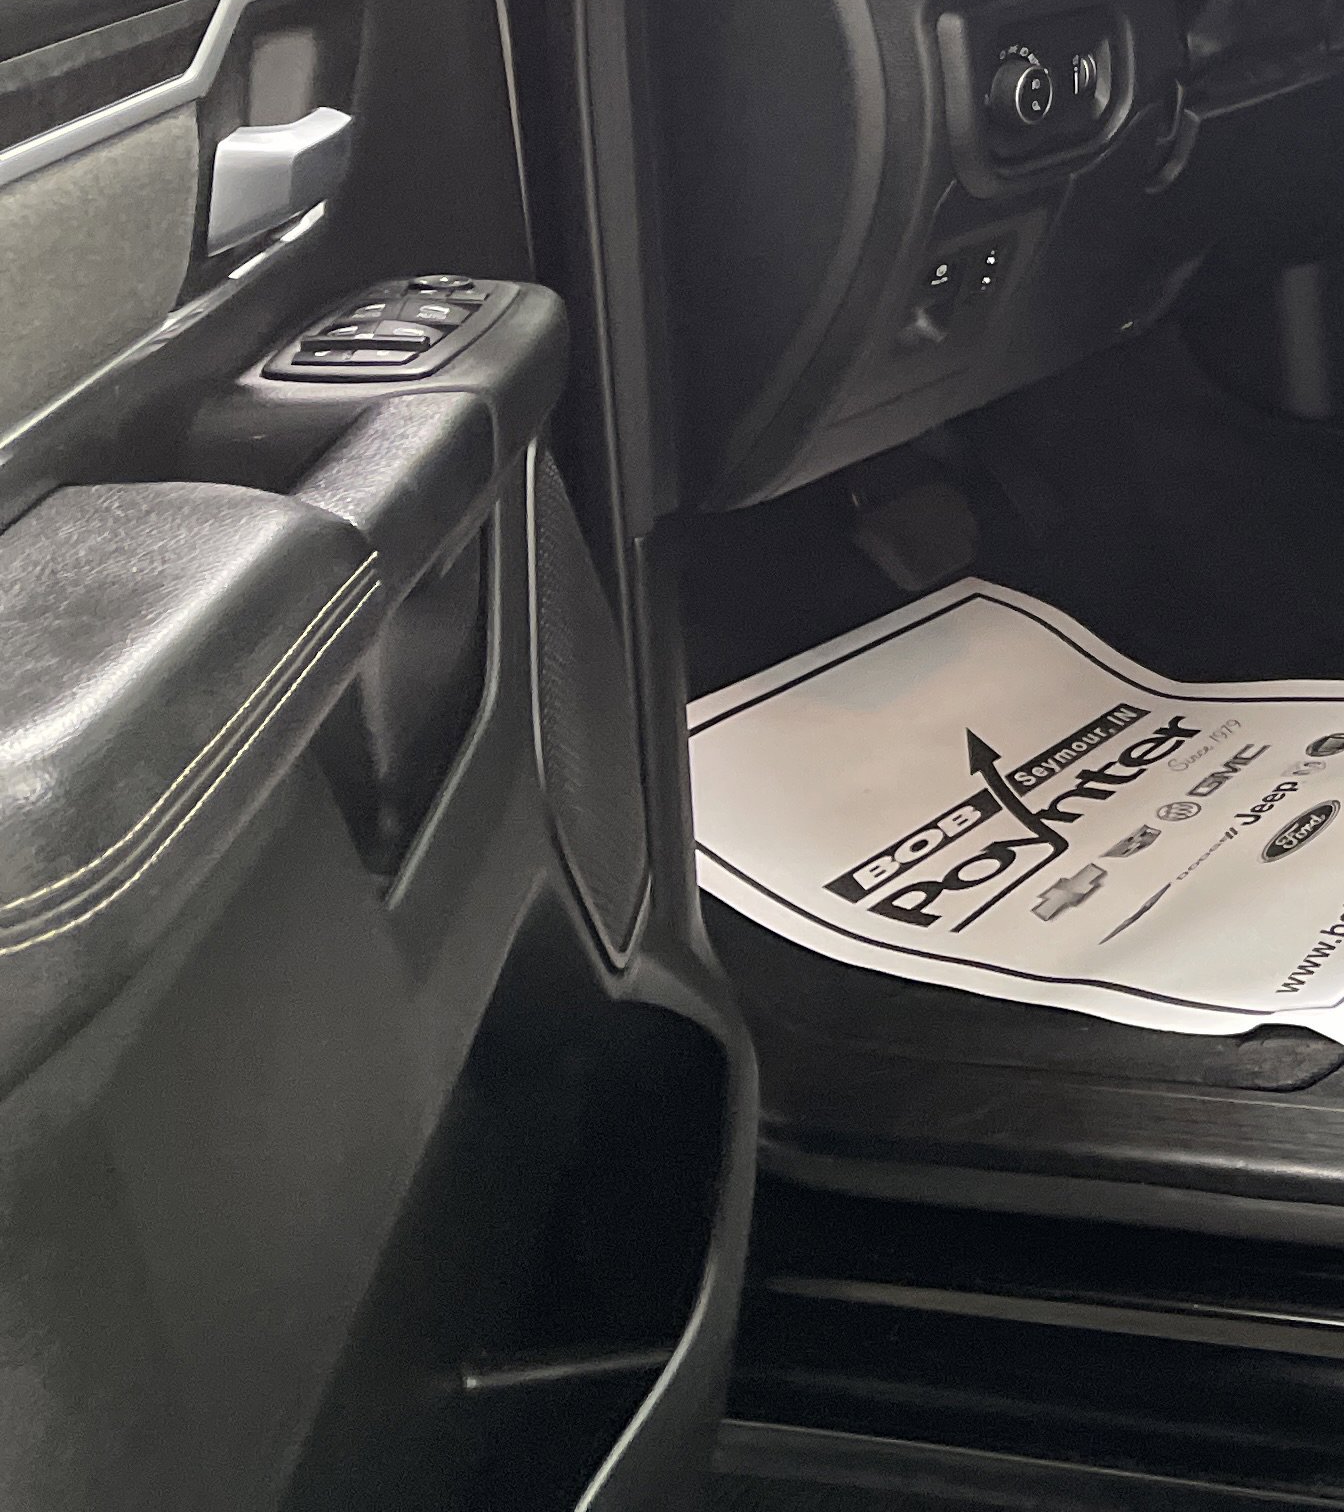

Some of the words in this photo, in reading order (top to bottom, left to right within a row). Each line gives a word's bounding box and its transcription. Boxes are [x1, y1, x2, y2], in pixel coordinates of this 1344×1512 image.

[1106, 707, 1138, 727] IN
[1186, 743, 1272, 797] GMC
[1233, 781, 1299, 826] Jeep
[852, 804, 983, 890] BOB
[1275, 813, 1326, 849] Ford
